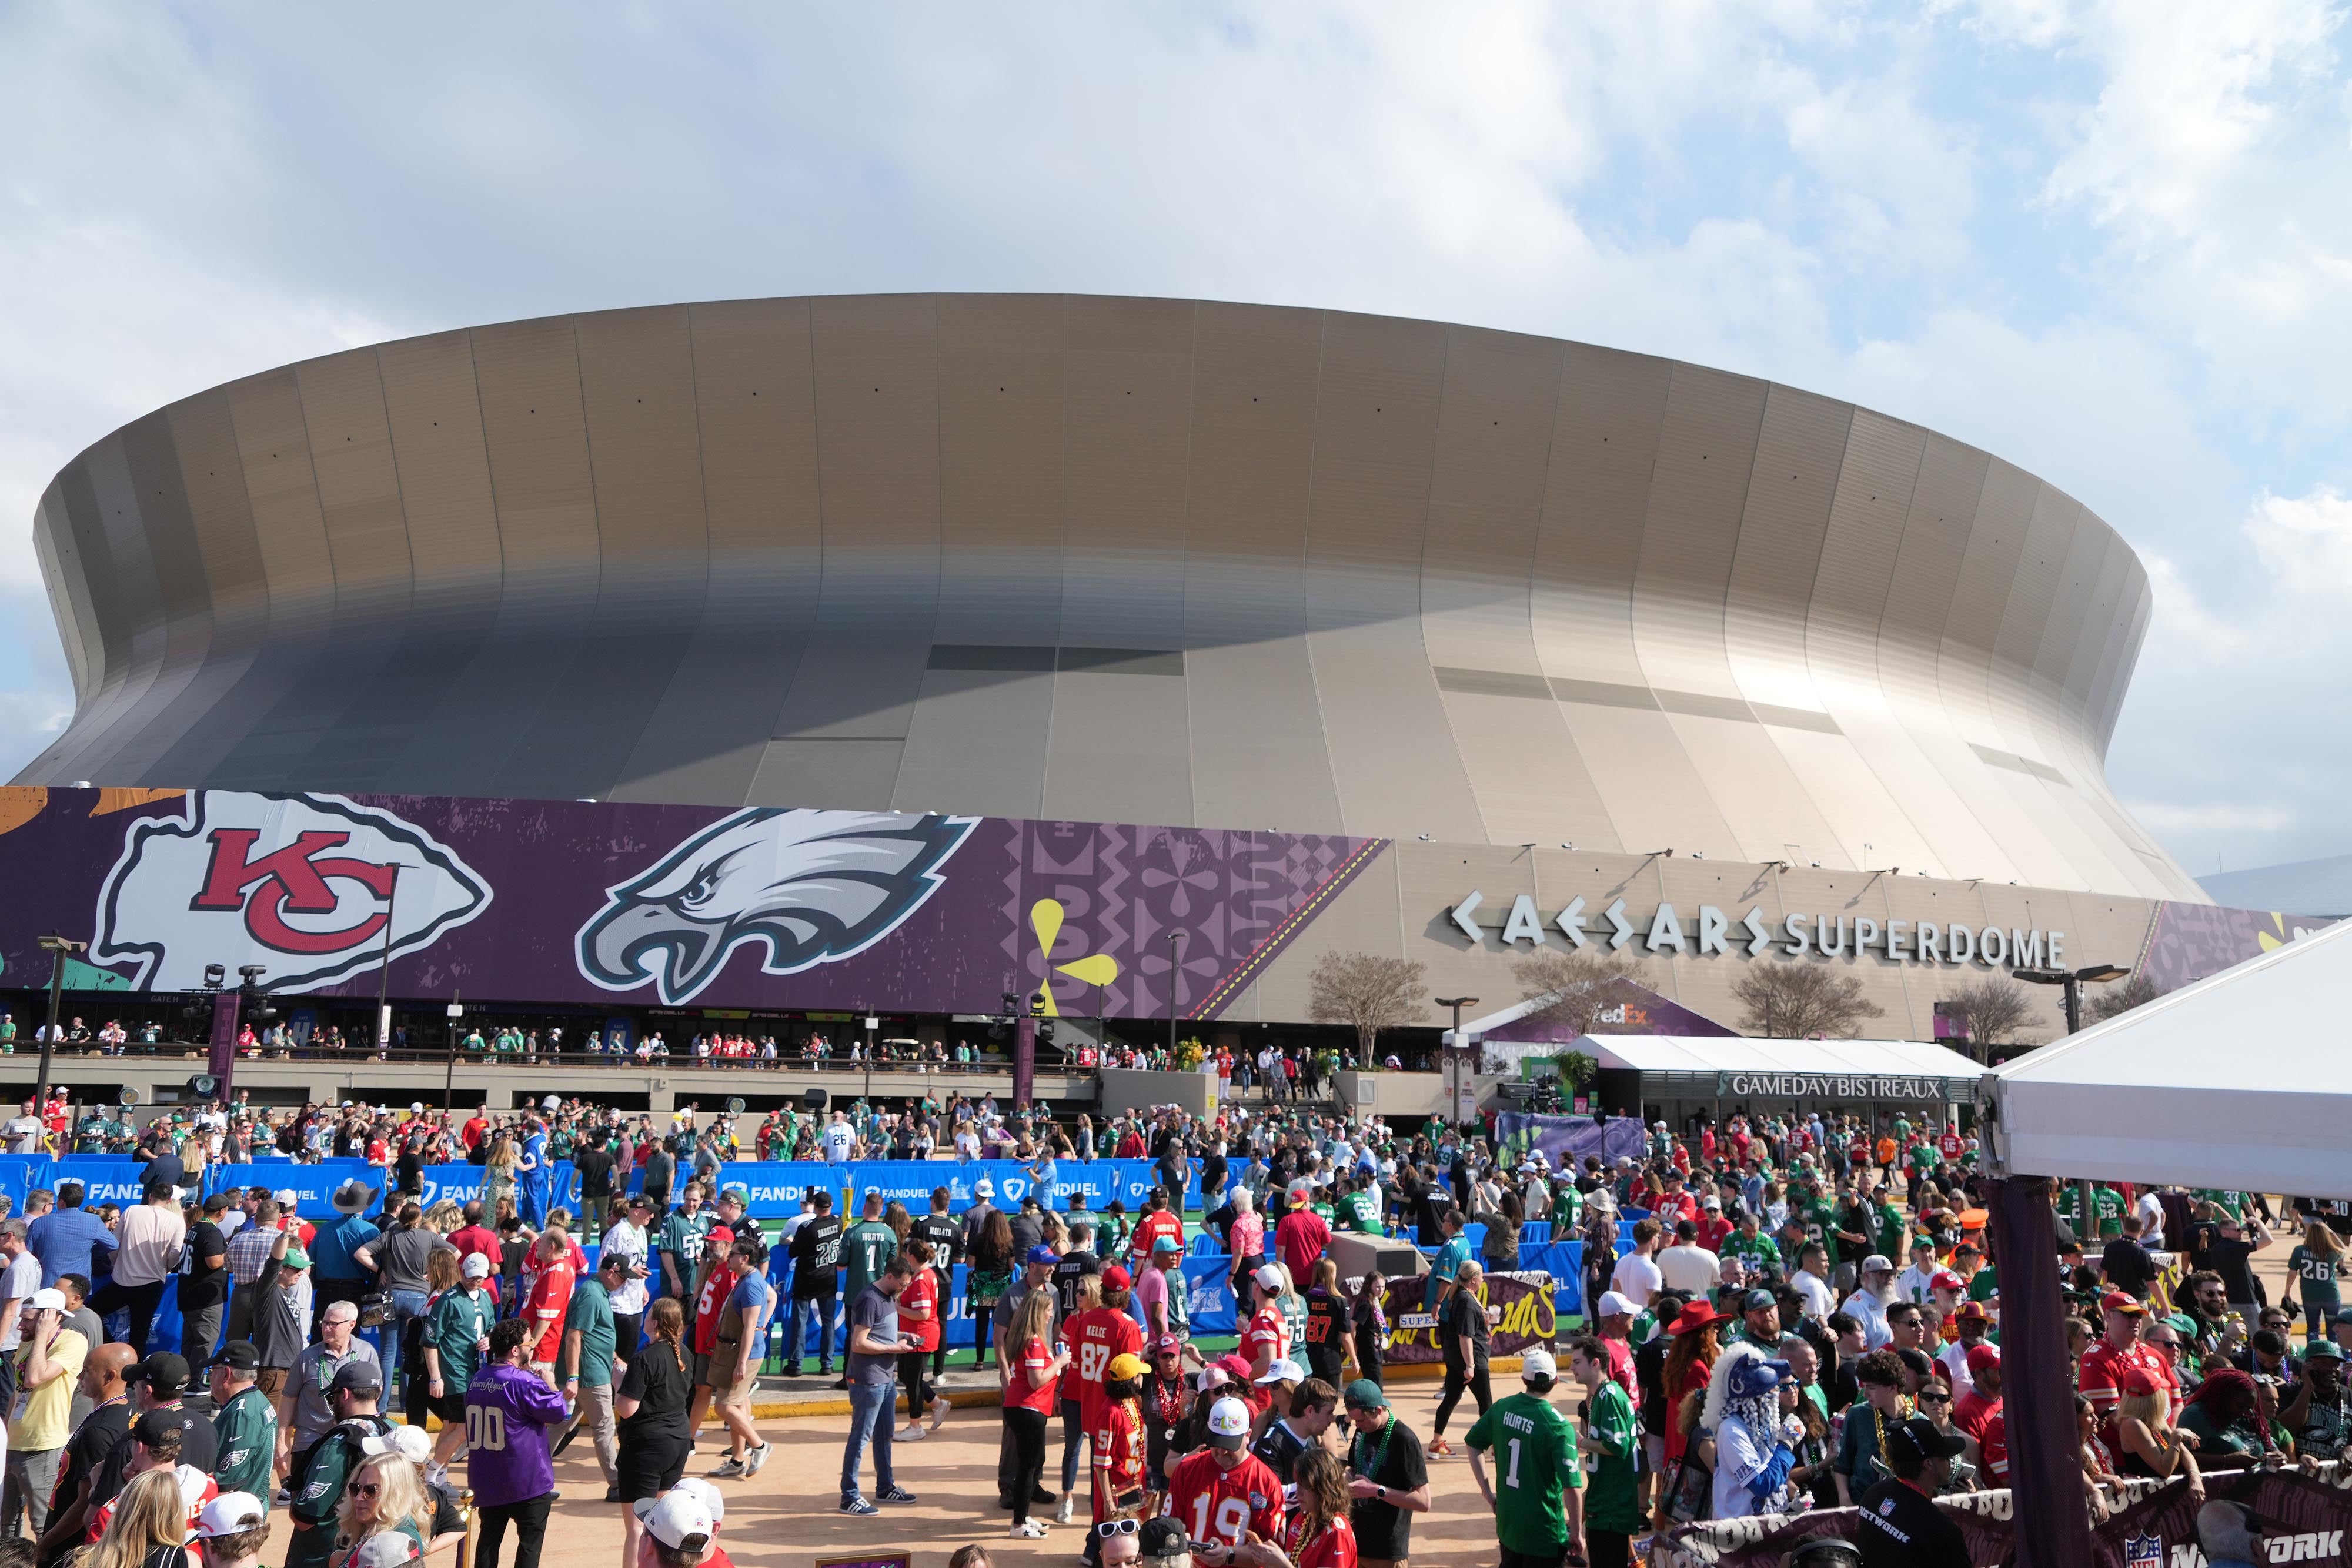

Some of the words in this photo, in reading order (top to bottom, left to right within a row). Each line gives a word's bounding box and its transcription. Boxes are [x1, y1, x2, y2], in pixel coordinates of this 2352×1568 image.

[189, 828, 393, 955] KC
[1451, 890, 1771, 957] CAESARS
[1783, 912, 2067, 969] SUPERDOME
[293, 1021, 310, 1047] H
[1732, 1075, 1833, 1096] GAMEDAY
[1838, 1079, 1940, 1099] BISTREAUX
[833, 1134, 847, 1145] 26
[1432, 1129, 1436, 1140] 1
[1792, 1136, 1803, 1147] 15
[89, 1183, 144, 1200] FAND
[882, 1188, 931, 1199] FANDUEL
[2224, 1191, 2239, 1205] 33
[1353, 1202, 1378, 1221] 62
[2099, 1202, 2117, 1219] 62
[817, 1224, 839, 1239] BARKLEY
[862, 1232, 884, 1242] HURTS
[929, 1226, 951, 1237] MAILATA
[682, 1233, 704, 1259] 55
[815, 1240, 839, 1269] 26
[178, 1244, 193, 1276] 26
[866, 1245, 876, 1272] 1
[2300, 1259, 2330, 1281] 26
[446, 1289, 457, 1298] 1
[1063, 1279, 1074, 1309] 1
[1311, 1302, 1328, 1311] KELCE
[473, 1315, 485, 1340] 1
[1086, 1325, 1107, 1339] KELCE
[1286, 1315, 1305, 1343] 55
[1306, 1315, 1332, 1344] 87
[1080, 1342, 1110, 1383] 87
[469, 1377, 487, 1392] Crown
[483, 1378, 509, 1393] Royal
[236, 1398, 246, 1410] 1
[1551, 1407, 1566, 1422] 1
[466, 1405, 506, 1451] 00
[1502, 1410, 1534, 1435] HURTS
[1505, 1437, 1521, 1489] 1
[1192, 1491, 1251, 1547] 19
[1859, 1505, 1910, 1543] NETWORK
